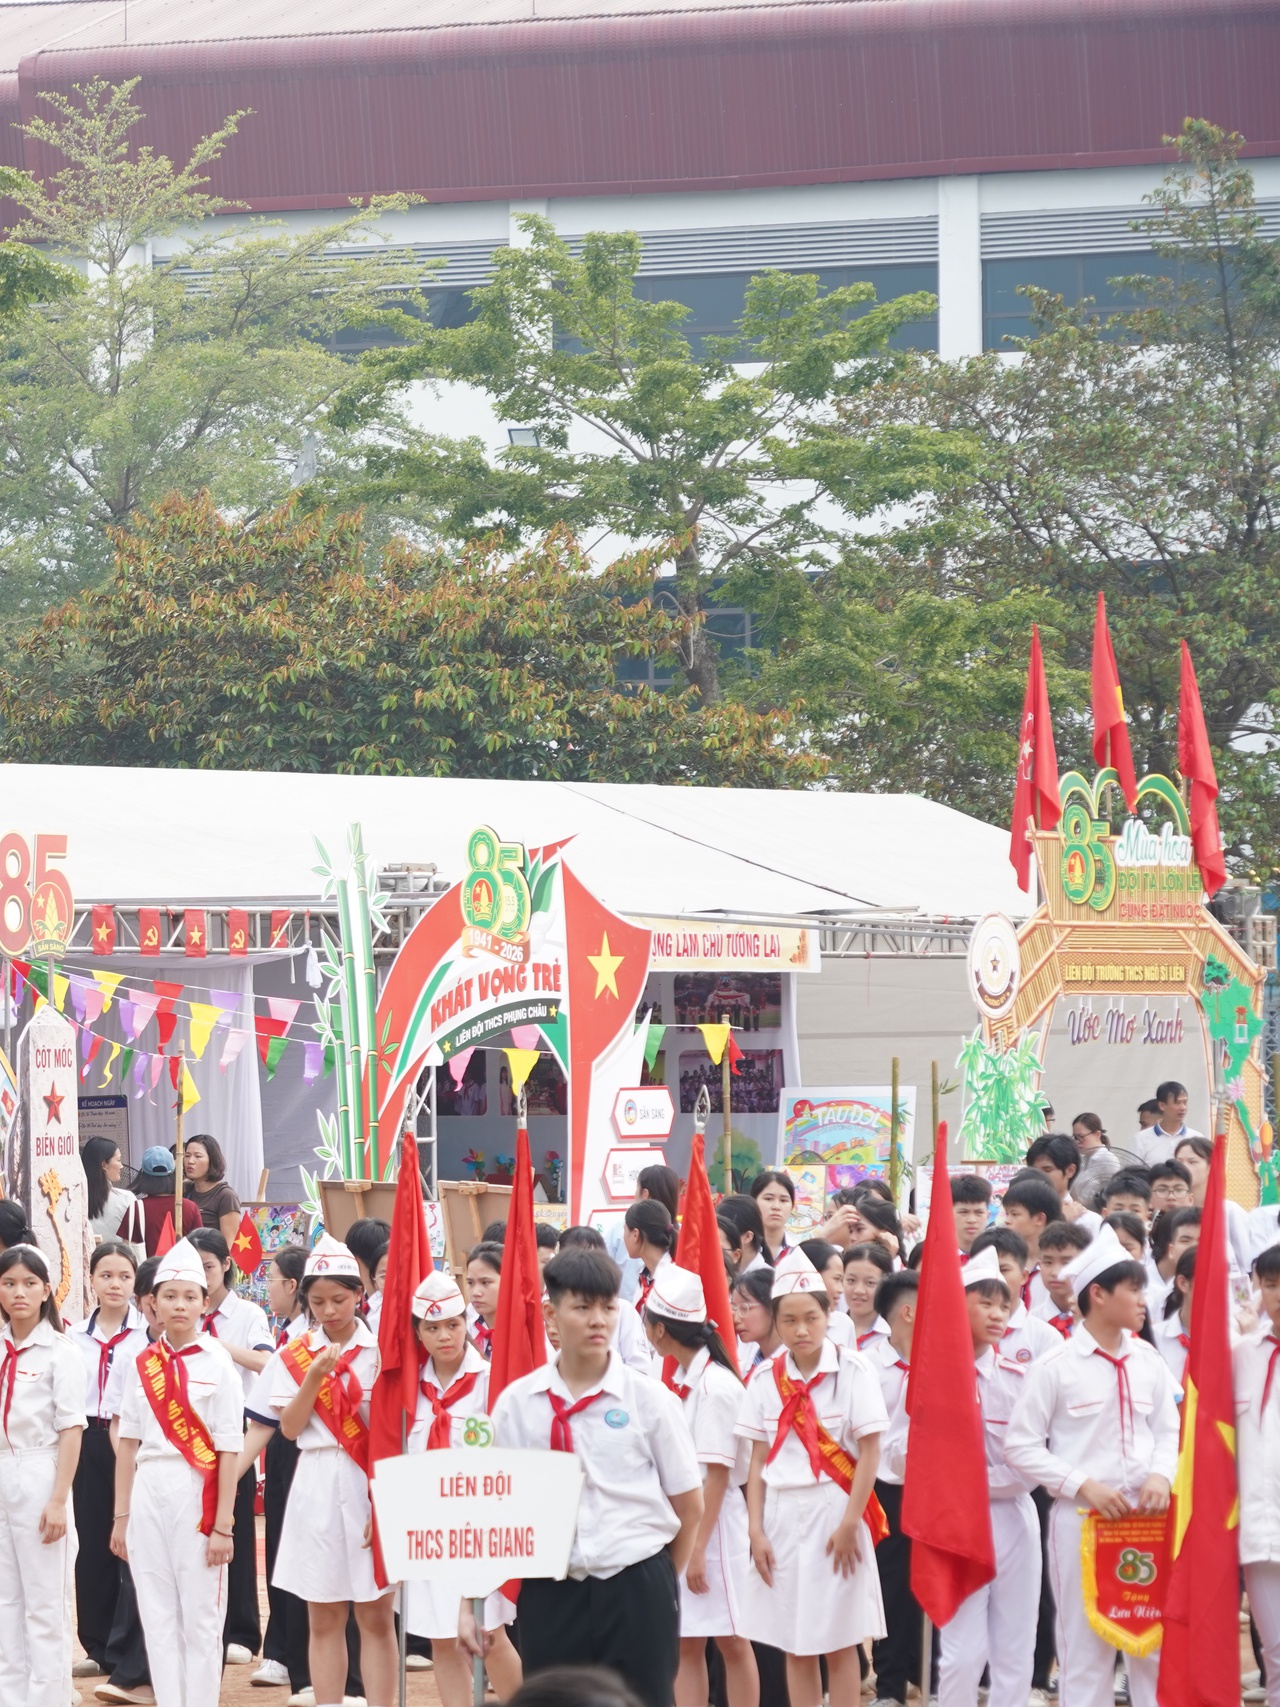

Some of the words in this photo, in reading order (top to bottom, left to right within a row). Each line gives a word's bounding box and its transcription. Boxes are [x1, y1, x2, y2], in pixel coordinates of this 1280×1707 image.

[1061, 804, 1117, 912] 85
[1117, 820, 1158, 863] Mùa
[1163, 822, 1190, 863] hoa
[461, 825, 532, 941] 85
[1119, 868, 1141, 896] ĐỘI
[1142, 872, 1158, 892] TA
[1161, 867, 1184, 891] LỚN
[1119, 900, 1149, 919] CÙNG
[1151, 897, 1171, 919] ĐẤT
[1172, 901, 1202, 919] NƯỚC
[468, 929, 493, 950] 1941
[500, 942, 524, 962] 2026
[676, 928, 699, 957] LÀM
[702, 925, 724, 957] CHỦ
[726, 931, 760, 957] TƯƠNG
[764, 934, 780, 957] LAI
[1065, 962, 1080, 982] LIÊN
[1081, 962, 1095, 985] ĐỘI
[1125, 965, 1144, 982] THCS
[1144, 963, 1159, 982] NGÔ
[1169, 962, 1185, 982] LIÊN
[431, 977, 474, 1034] KHÁT
[478, 964, 528, 1003] VỌNG
[532, 957, 562, 992] TRẺ
[455, 1028, 472, 1047] LIÊN
[471, 1020, 485, 1040] ĐỘI
[485, 1016, 503, 1032] THCS
[503, 1008, 527, 1023] PHỤNG
[527, 1003, 548, 1018] CHÂU
[1067, 1006, 1102, 1046] Ước
[1105, 1008, 1138, 1044] Mơ
[1142, 1007, 1185, 1045] Xanh
[35, 1045, 51, 1072] CỘT
[54, 1039, 73, 1068] MỐC
[35, 1132, 55, 1157] BIÊN
[57, 1131, 74, 1155] GIỚI
[145, 1354, 163, 1377] ĐỘI
[463, 1416, 492, 1448] 85
[440, 1472, 477, 1498] LIÊN
[483, 1471, 512, 1500] ĐỘI
[407, 1529, 444, 1561] THCS
[449, 1522, 484, 1559] BIÊN
[488, 1526, 535, 1559] GIANG
[1116, 1547, 1158, 1587] 85
